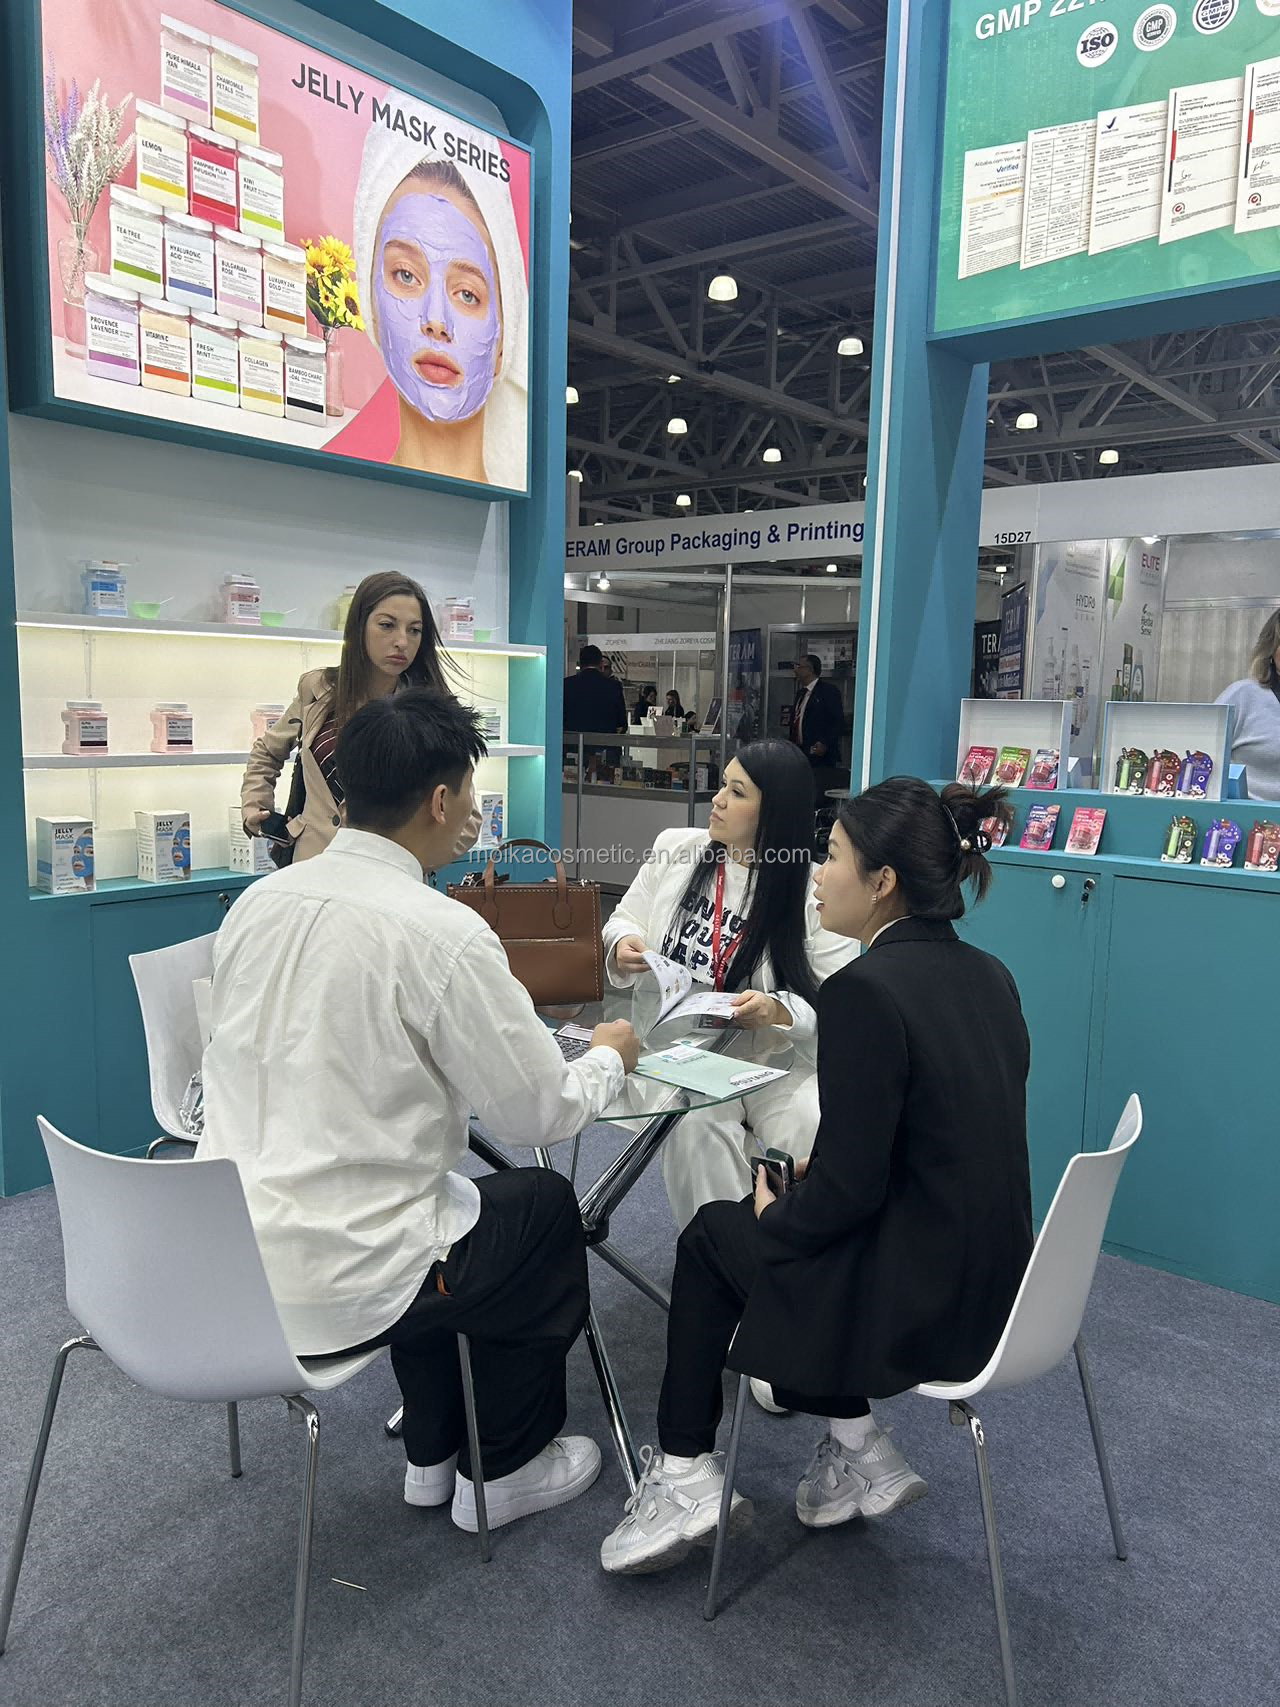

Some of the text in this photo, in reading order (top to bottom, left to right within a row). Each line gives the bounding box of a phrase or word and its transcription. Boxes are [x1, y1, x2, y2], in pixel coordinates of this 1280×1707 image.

[976, 0, 1042, 40] GMP
[1146, 18, 1164, 32] GMP
[1080, 32, 1114, 54] ISO
[166, 52, 180, 62] PURE
[216, 75, 244, 91] CHAMOMILE
[216, 82, 234, 94] PETALS
[291, 63, 364, 115] JELLY
[372, 97, 436, 150] MASK
[443, 132, 510, 182] SERIES
[142, 140, 162, 152] LEMON
[193, 159, 228, 176] VAMPIRE PLLA
[193, 166, 217, 179] INFUSION
[996, 163, 1019, 173] Verified
[244, 177, 254, 185] KIWI
[244, 184, 258, 194] FRUIT
[116, 226, 141, 240] TEA TREE
[170, 245, 201, 260] HYALURONIC
[170, 252, 182, 261] ACID
[221, 260, 248, 274] BULGARIAN
[221, 268, 234, 276] ROSE
[268, 275, 286, 286] LUXURY
[268, 282, 282, 291] GOLD
[90, 316, 118, 328] PROVENCE
[90, 324, 119, 335] LAVENDER
[145, 330, 164, 341] VITAMIN
[196, 343, 214, 352] FRESH
[196, 350, 211, 359] MINT
[244, 356, 268, 368] COLLAGEN
[288, 367, 308, 378] BAMBOO
[566, 520, 864, 558] ERAM Group Packaging & Printing
[994, 531, 1031, 544] 15D27
[1142, 553, 1160, 572] ELITE
